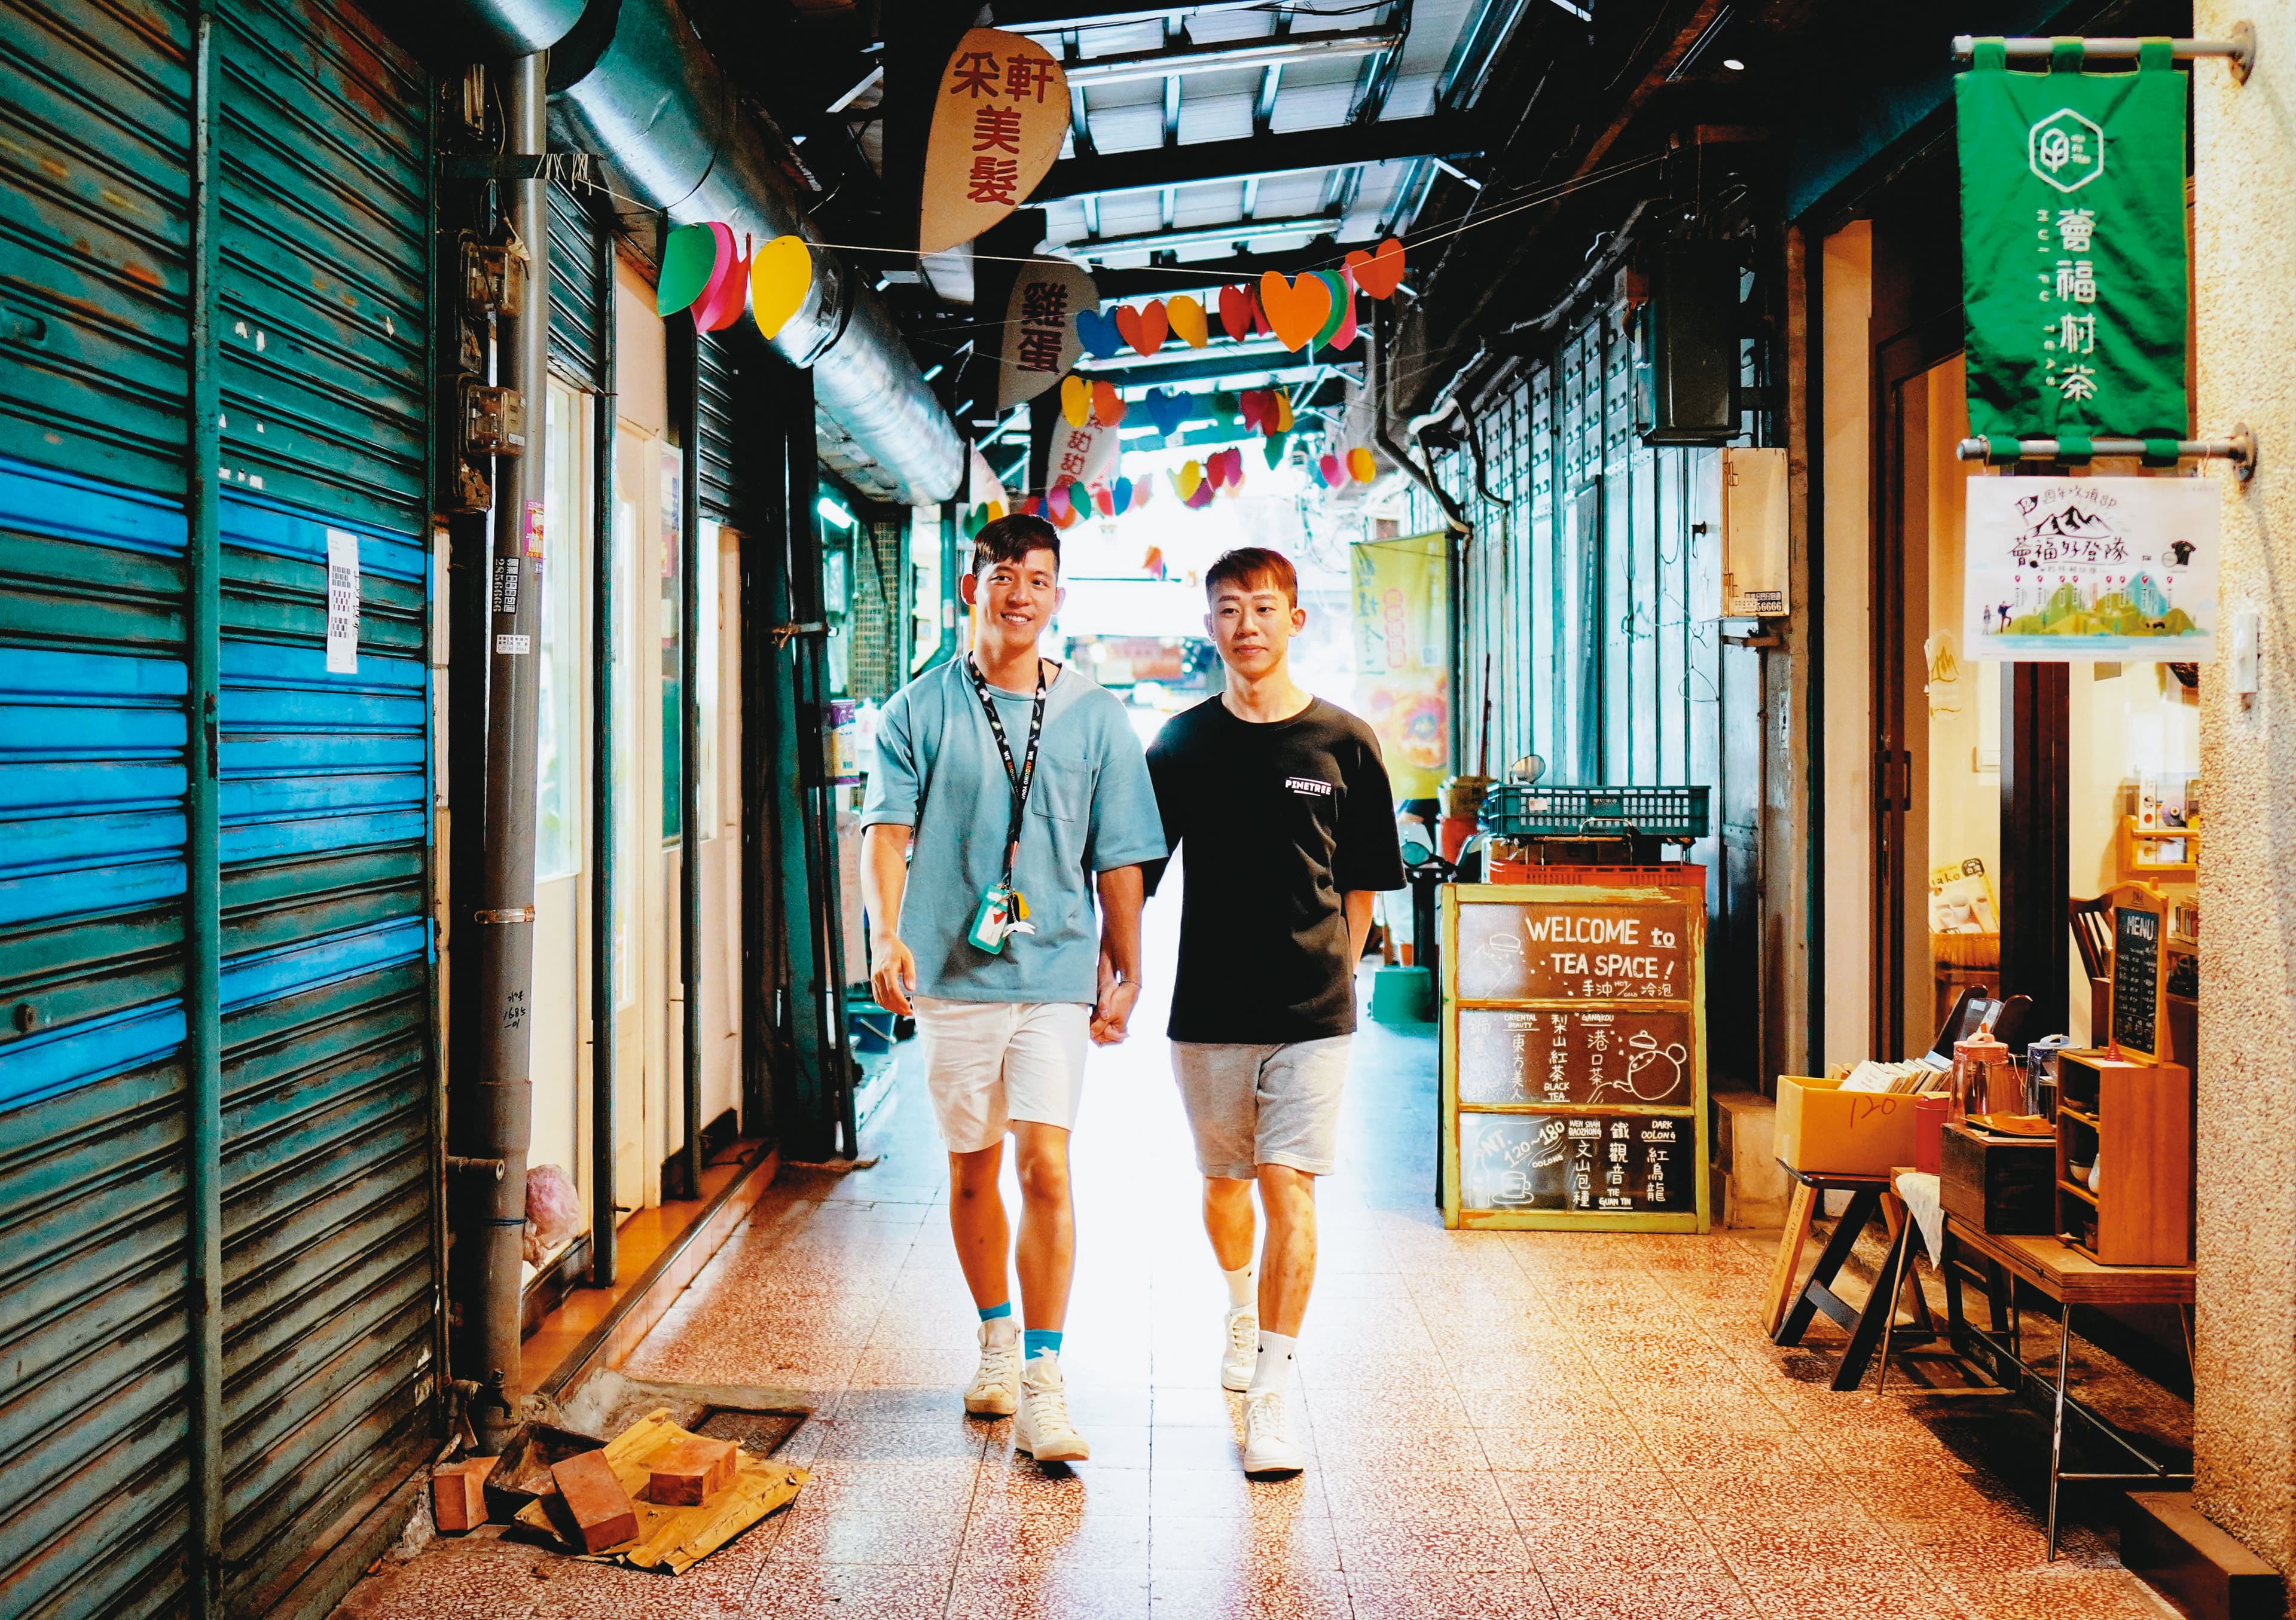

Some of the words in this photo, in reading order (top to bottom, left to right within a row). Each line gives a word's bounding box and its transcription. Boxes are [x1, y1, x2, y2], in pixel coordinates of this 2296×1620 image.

[967, 105, 1022, 206] 美髮
[2056, 207, 2097, 402] 薈福村茶
[1016, 282, 1068, 374] 雞蛋
[493, 558, 505, 612] 2856666
[1003, 750, 1010, 761] WE
[1027, 750, 1034, 760] WE
[1023, 761, 1032, 785] AROUND
[1286, 780, 1332, 795] PINETREE
[1525, 916, 1640, 945] WELCOME
[1651, 927, 1675, 946] to
[2126, 915, 2154, 941] MENU
[1550, 953, 1589, 974] TEA
[1595, 954, 1659, 979] SPACE
[1641, 982, 1673, 997] 冷泡
[1581, 1014, 1614, 1022] GANGKOU
[1549, 1014, 1568, 1082] 梨山紅茶
[1587, 1029, 1610, 1086] 港口茶
[1510, 1033, 1525, 1100] 東方美人
[1544, 1082, 1570, 1091] BLACK
[1548, 1092, 1565, 1101] TEA
[1651, 1120, 1672, 1129] DARK
[1851, 1096, 1897, 1129] 120
[1568, 1128, 1602, 1137] BAOZHONG
[1641, 1130, 1676, 1140] OOLONG
[1532, 1154, 1564, 1168] OOLONG
[1608, 1121, 1629, 1184] 鐵觀音
[1573, 1139, 1592, 1208] 文山包種
[1647, 1147, 1670, 1202] 紅烏龍
[1599, 1197, 1619, 1207] GUAN
[1620, 1197, 1631, 1206] YIN
[1607, 1188, 1620, 1197] TIE
